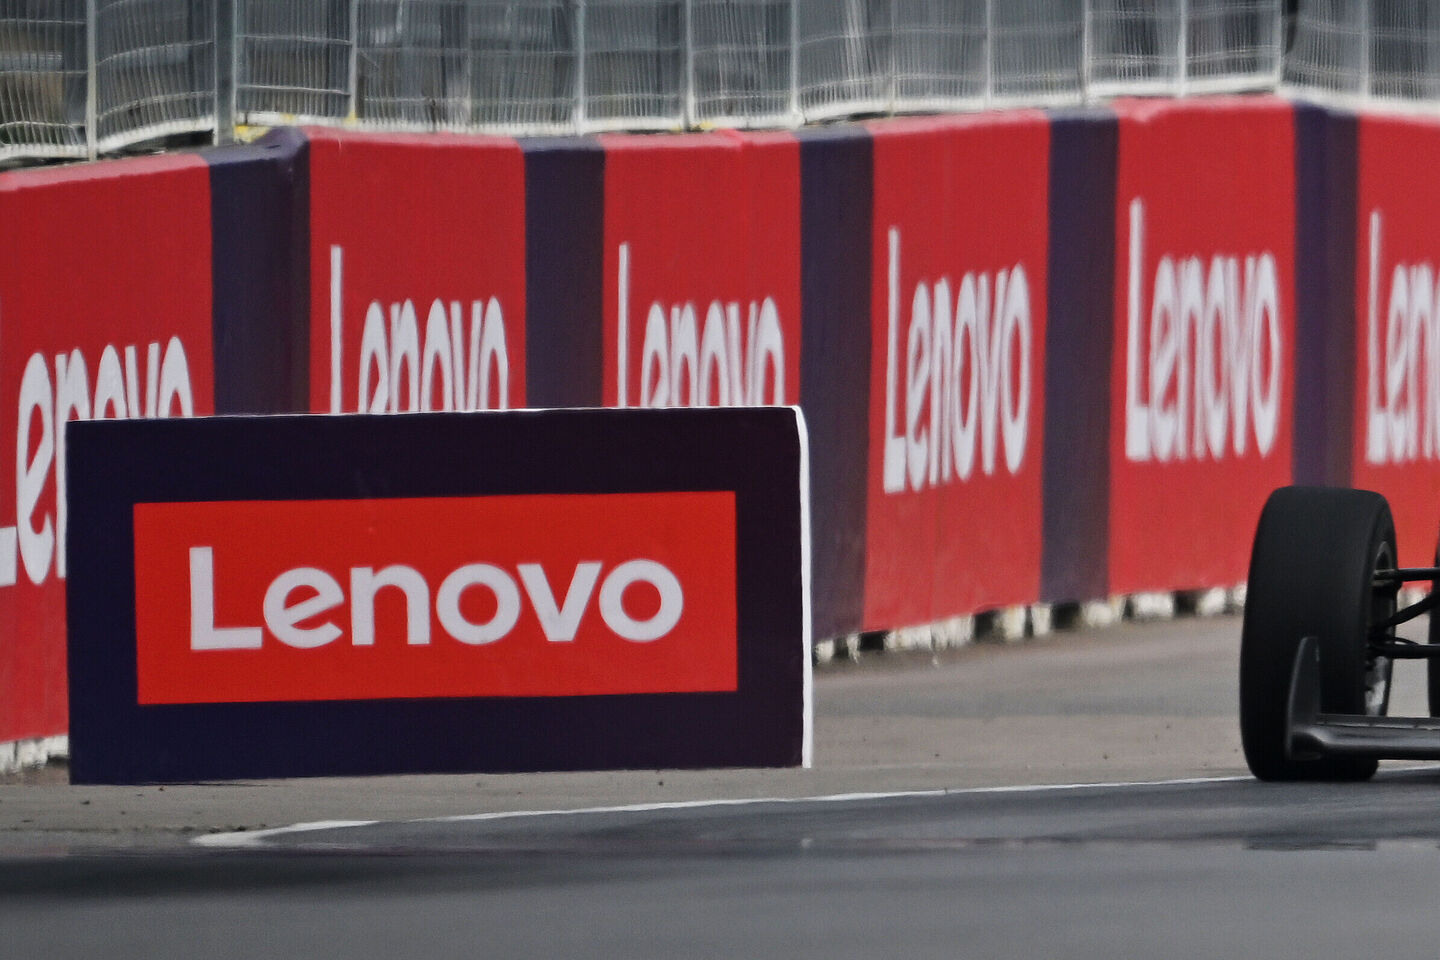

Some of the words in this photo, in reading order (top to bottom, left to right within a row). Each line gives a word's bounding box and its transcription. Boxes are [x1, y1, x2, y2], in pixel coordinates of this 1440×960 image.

[883, 225, 1032, 494] Lenovo
[1125, 196, 1282, 462] Lenovo
[189, 546, 684, 652] Lenovo
